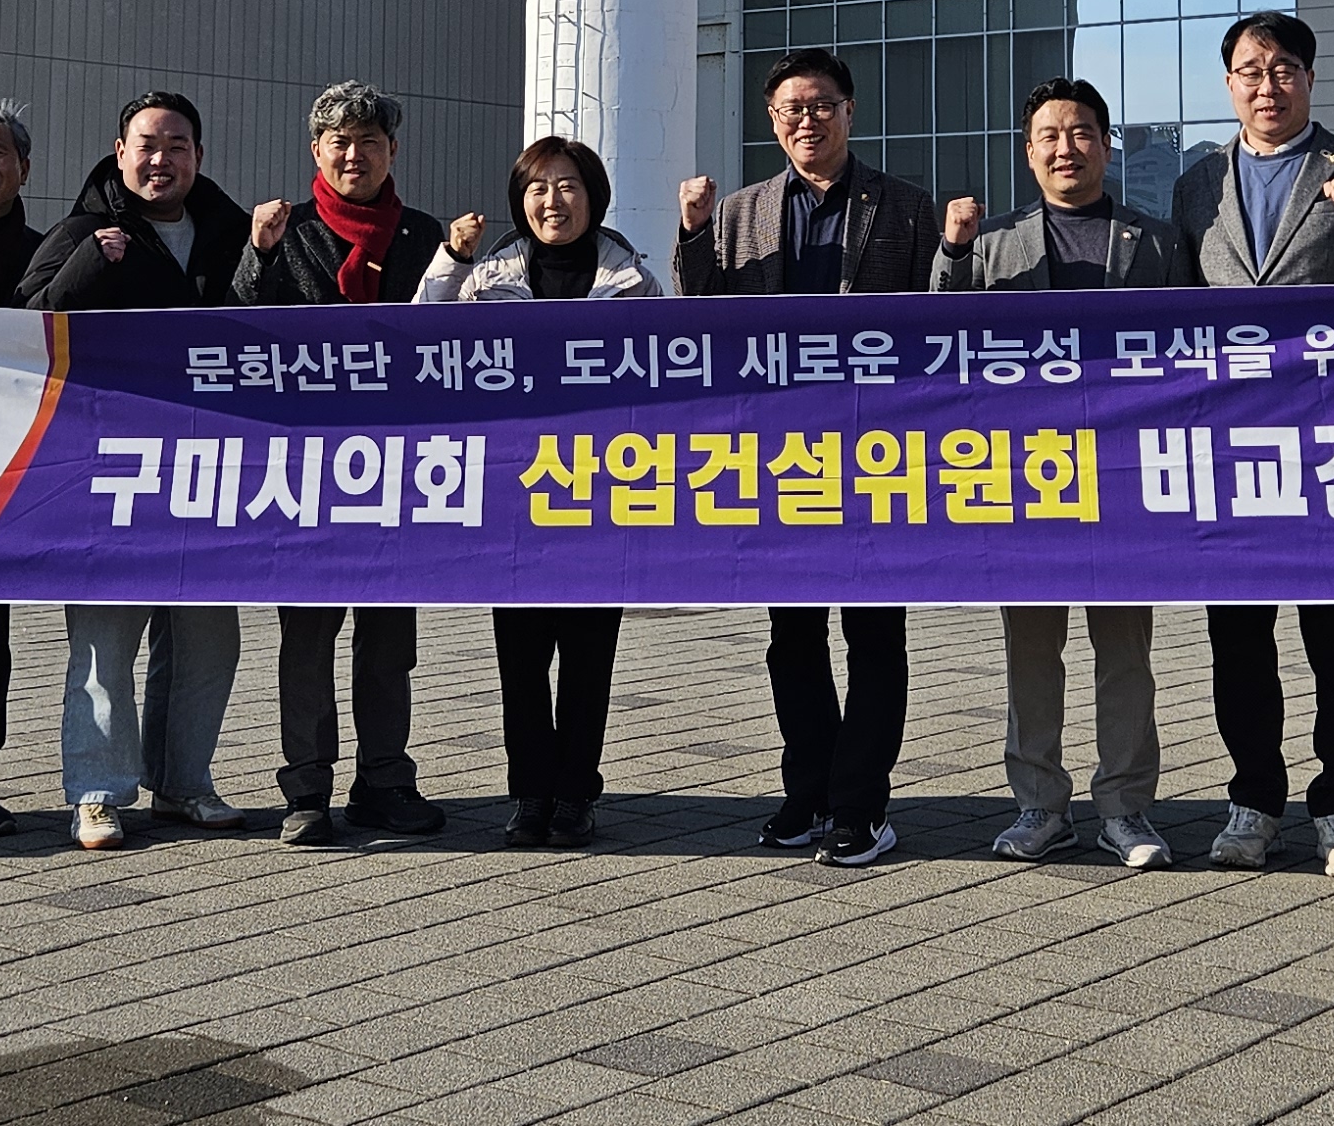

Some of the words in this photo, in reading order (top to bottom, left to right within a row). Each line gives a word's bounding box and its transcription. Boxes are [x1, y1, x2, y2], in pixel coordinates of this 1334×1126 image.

[186, 342, 392, 393] 문화산단
[416, 338, 534, 393] 재생,
[561, 334, 712, 388] 도시의
[739, 331, 899, 386] 새로운
[924, 329, 1082, 385] 가능성
[1110, 325, 1277, 381] 모색을
[89, 435, 487, 528] 구미시의회
[519, 429, 1100, 527] 산업건설위원회
